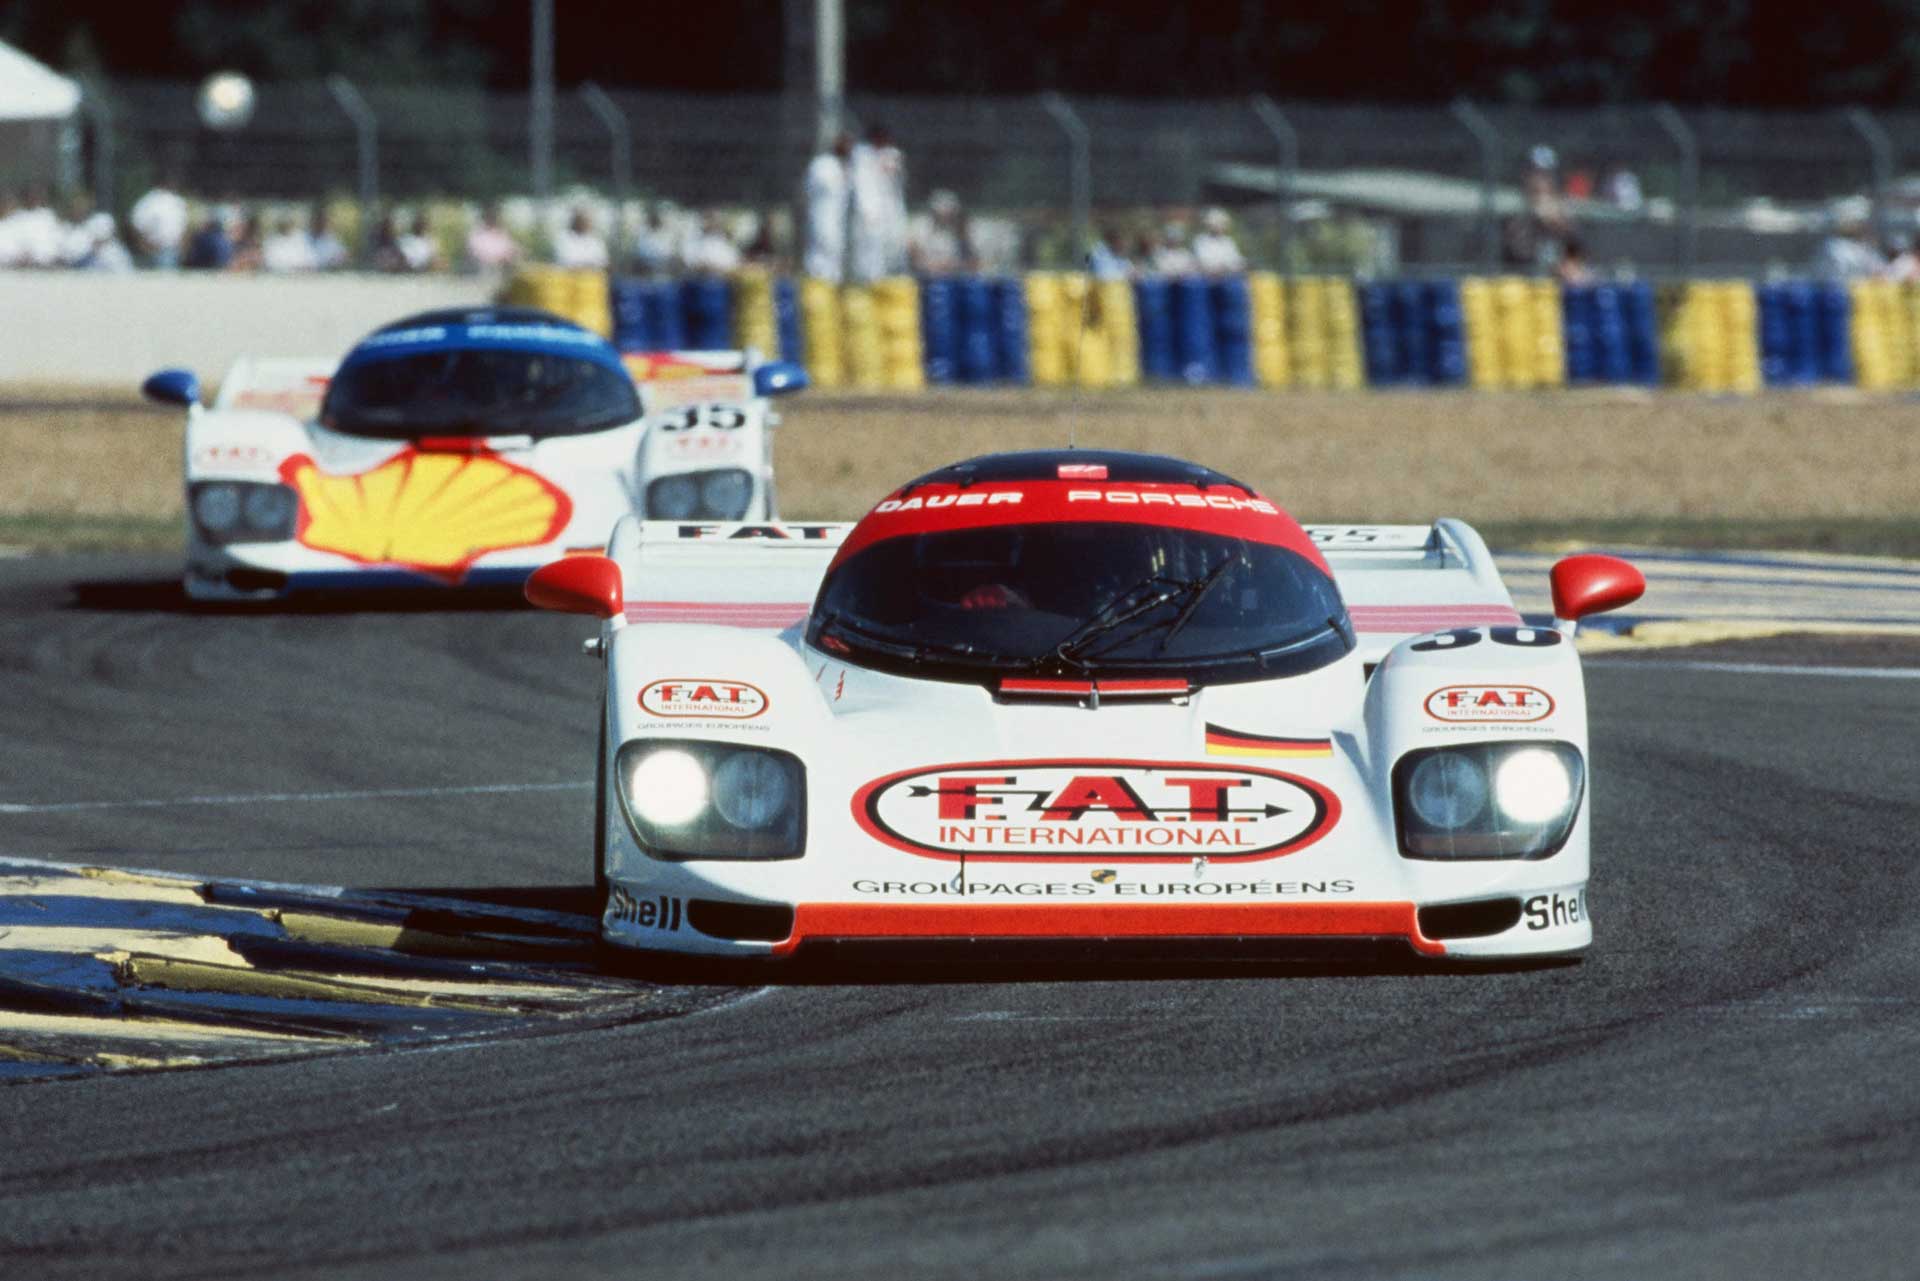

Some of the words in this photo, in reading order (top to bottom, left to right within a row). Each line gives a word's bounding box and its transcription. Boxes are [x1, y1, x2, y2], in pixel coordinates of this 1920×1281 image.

[662, 405, 746, 431] 35
[874, 491, 1024, 514] DAUER
[1068, 490, 1280, 515] PORSCHE
[660, 703, 746, 714] INTERNATIONAL
[1446, 708, 1532, 717] INTERNATIONAL
[937, 826, 1257, 847] INTERNATIONAL
[852, 879, 1096, 895] GROUPAGES
[1114, 878, 1356, 895] EUROPÉENS
[612, 885, 682, 932] Shell
